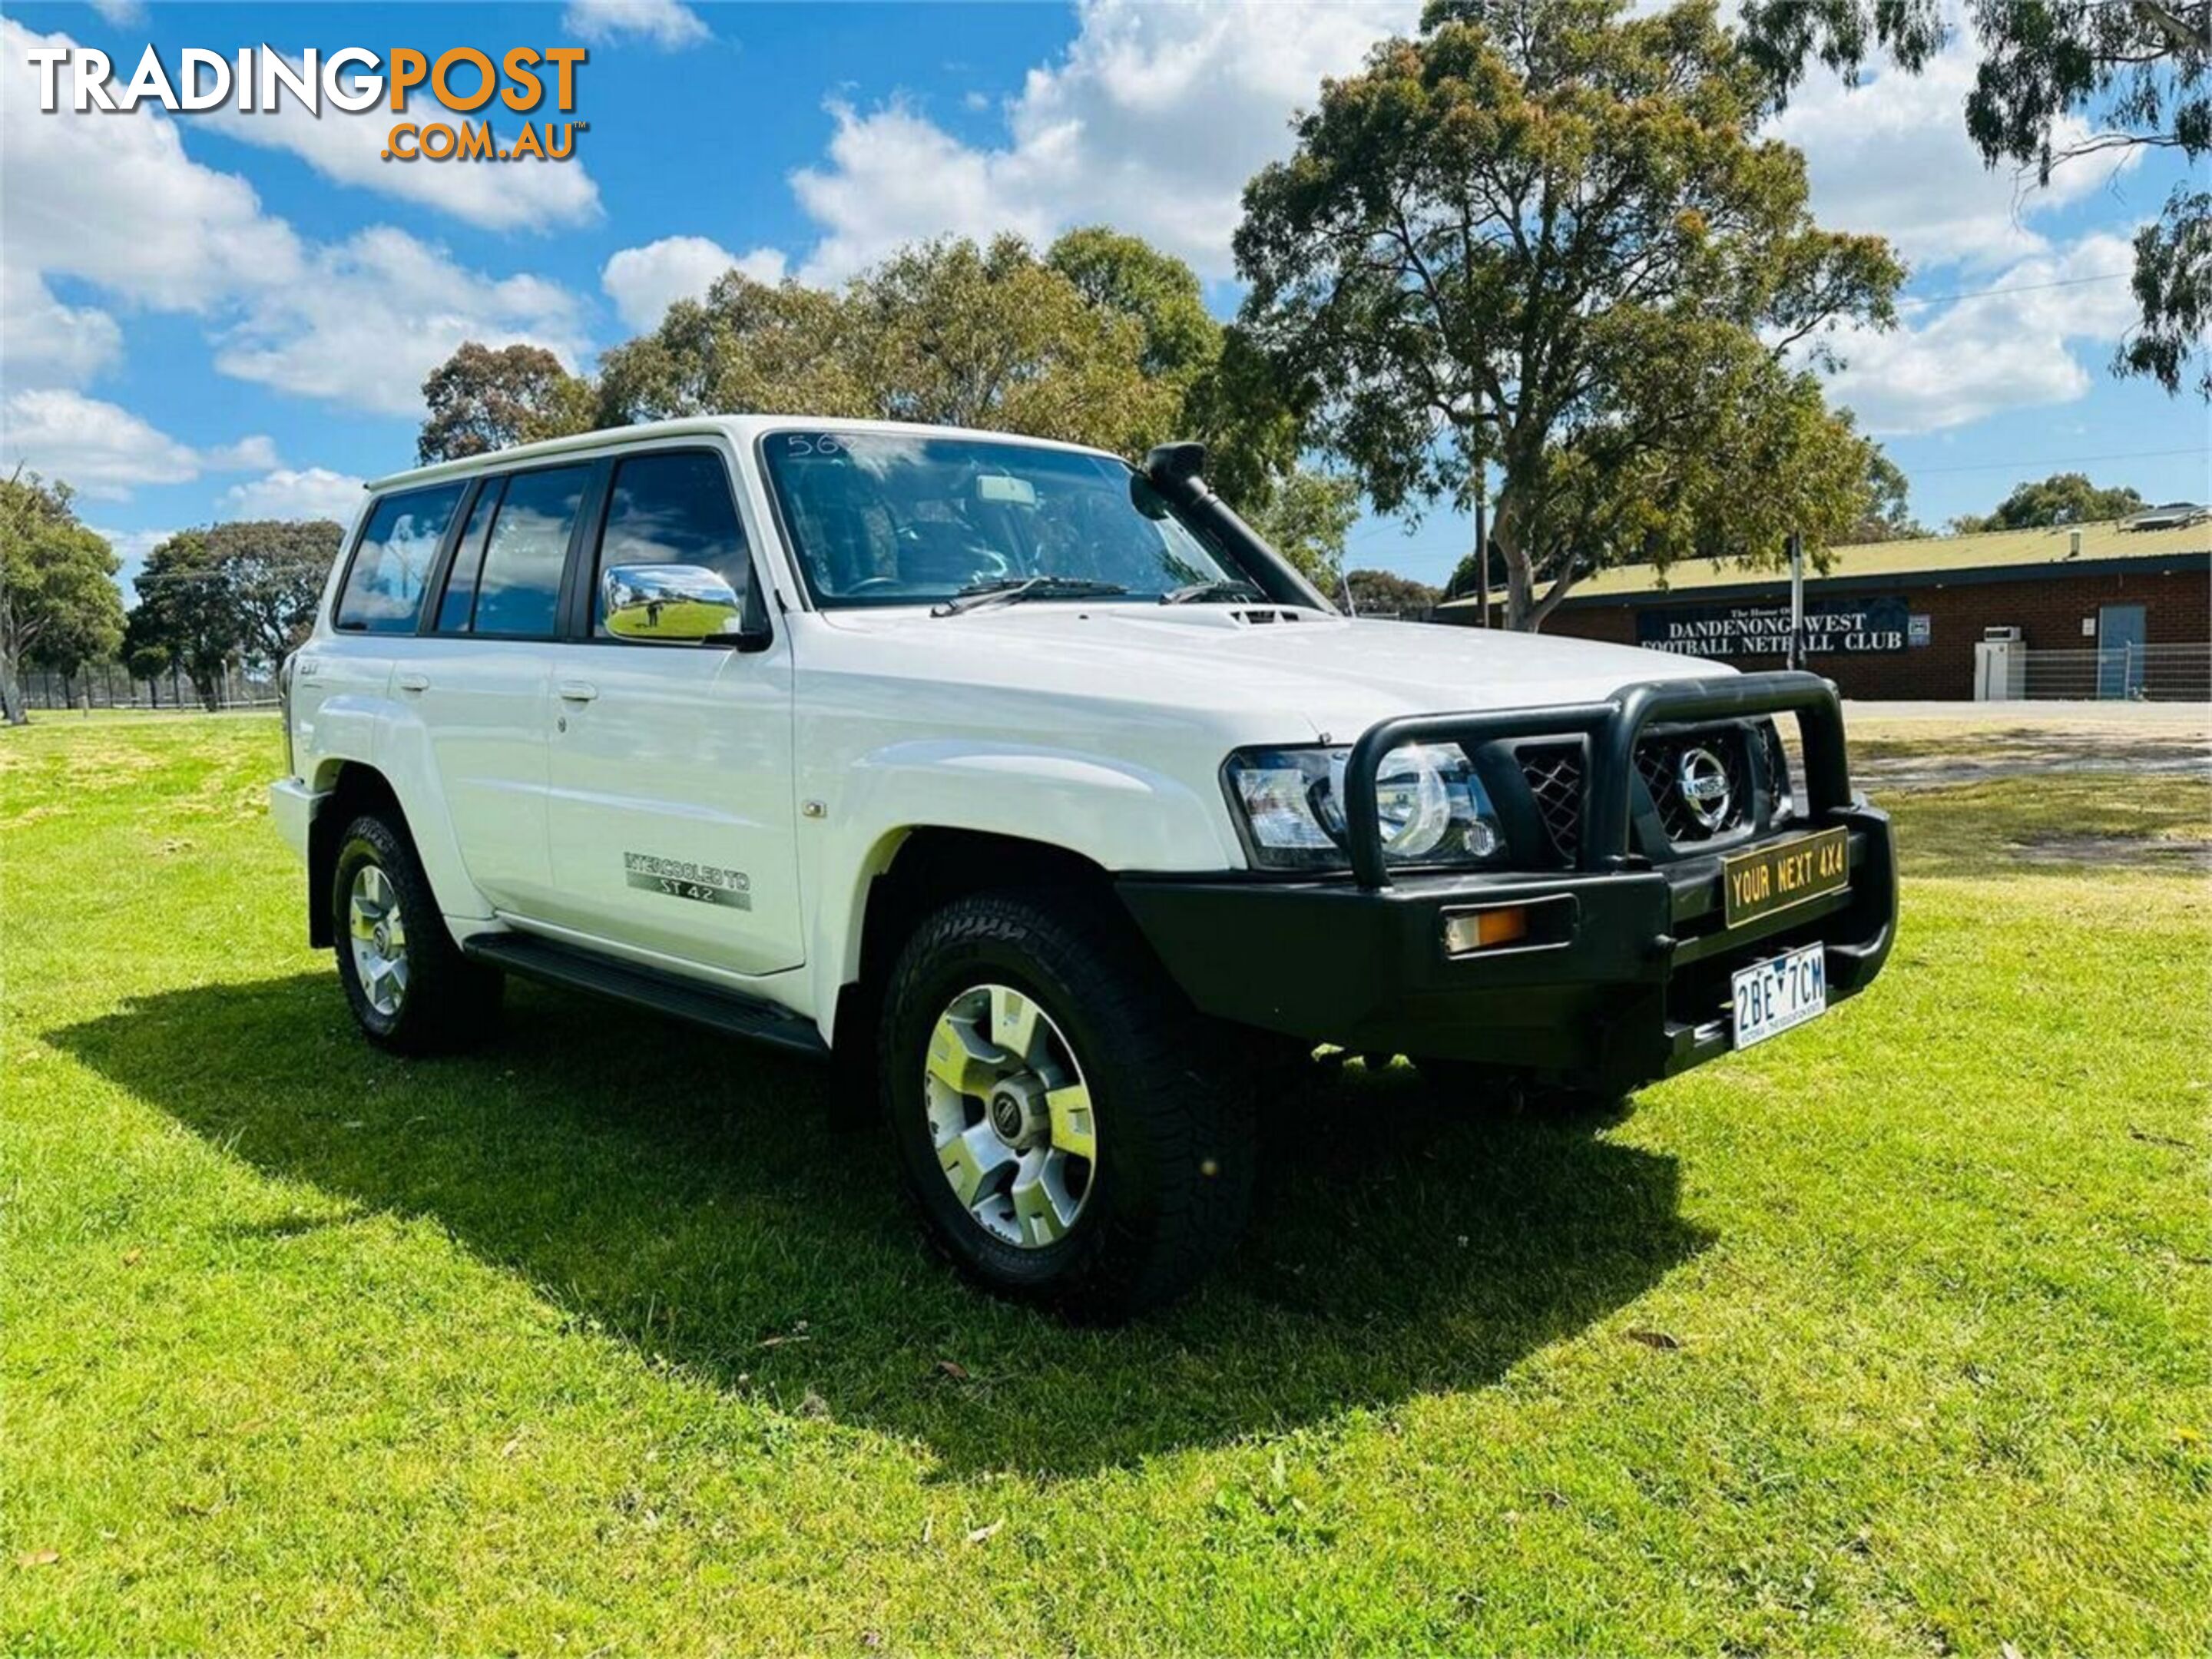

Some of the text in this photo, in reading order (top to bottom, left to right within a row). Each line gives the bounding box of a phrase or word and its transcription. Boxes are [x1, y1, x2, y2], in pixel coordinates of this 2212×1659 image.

[1670, 614, 1867, 638] DANDENONG WEST
[1845, 631, 1902, 651] CLUB
[1733, 842, 1843, 908] YOUR NEXT 4X4
[660, 879, 681, 894] ST
